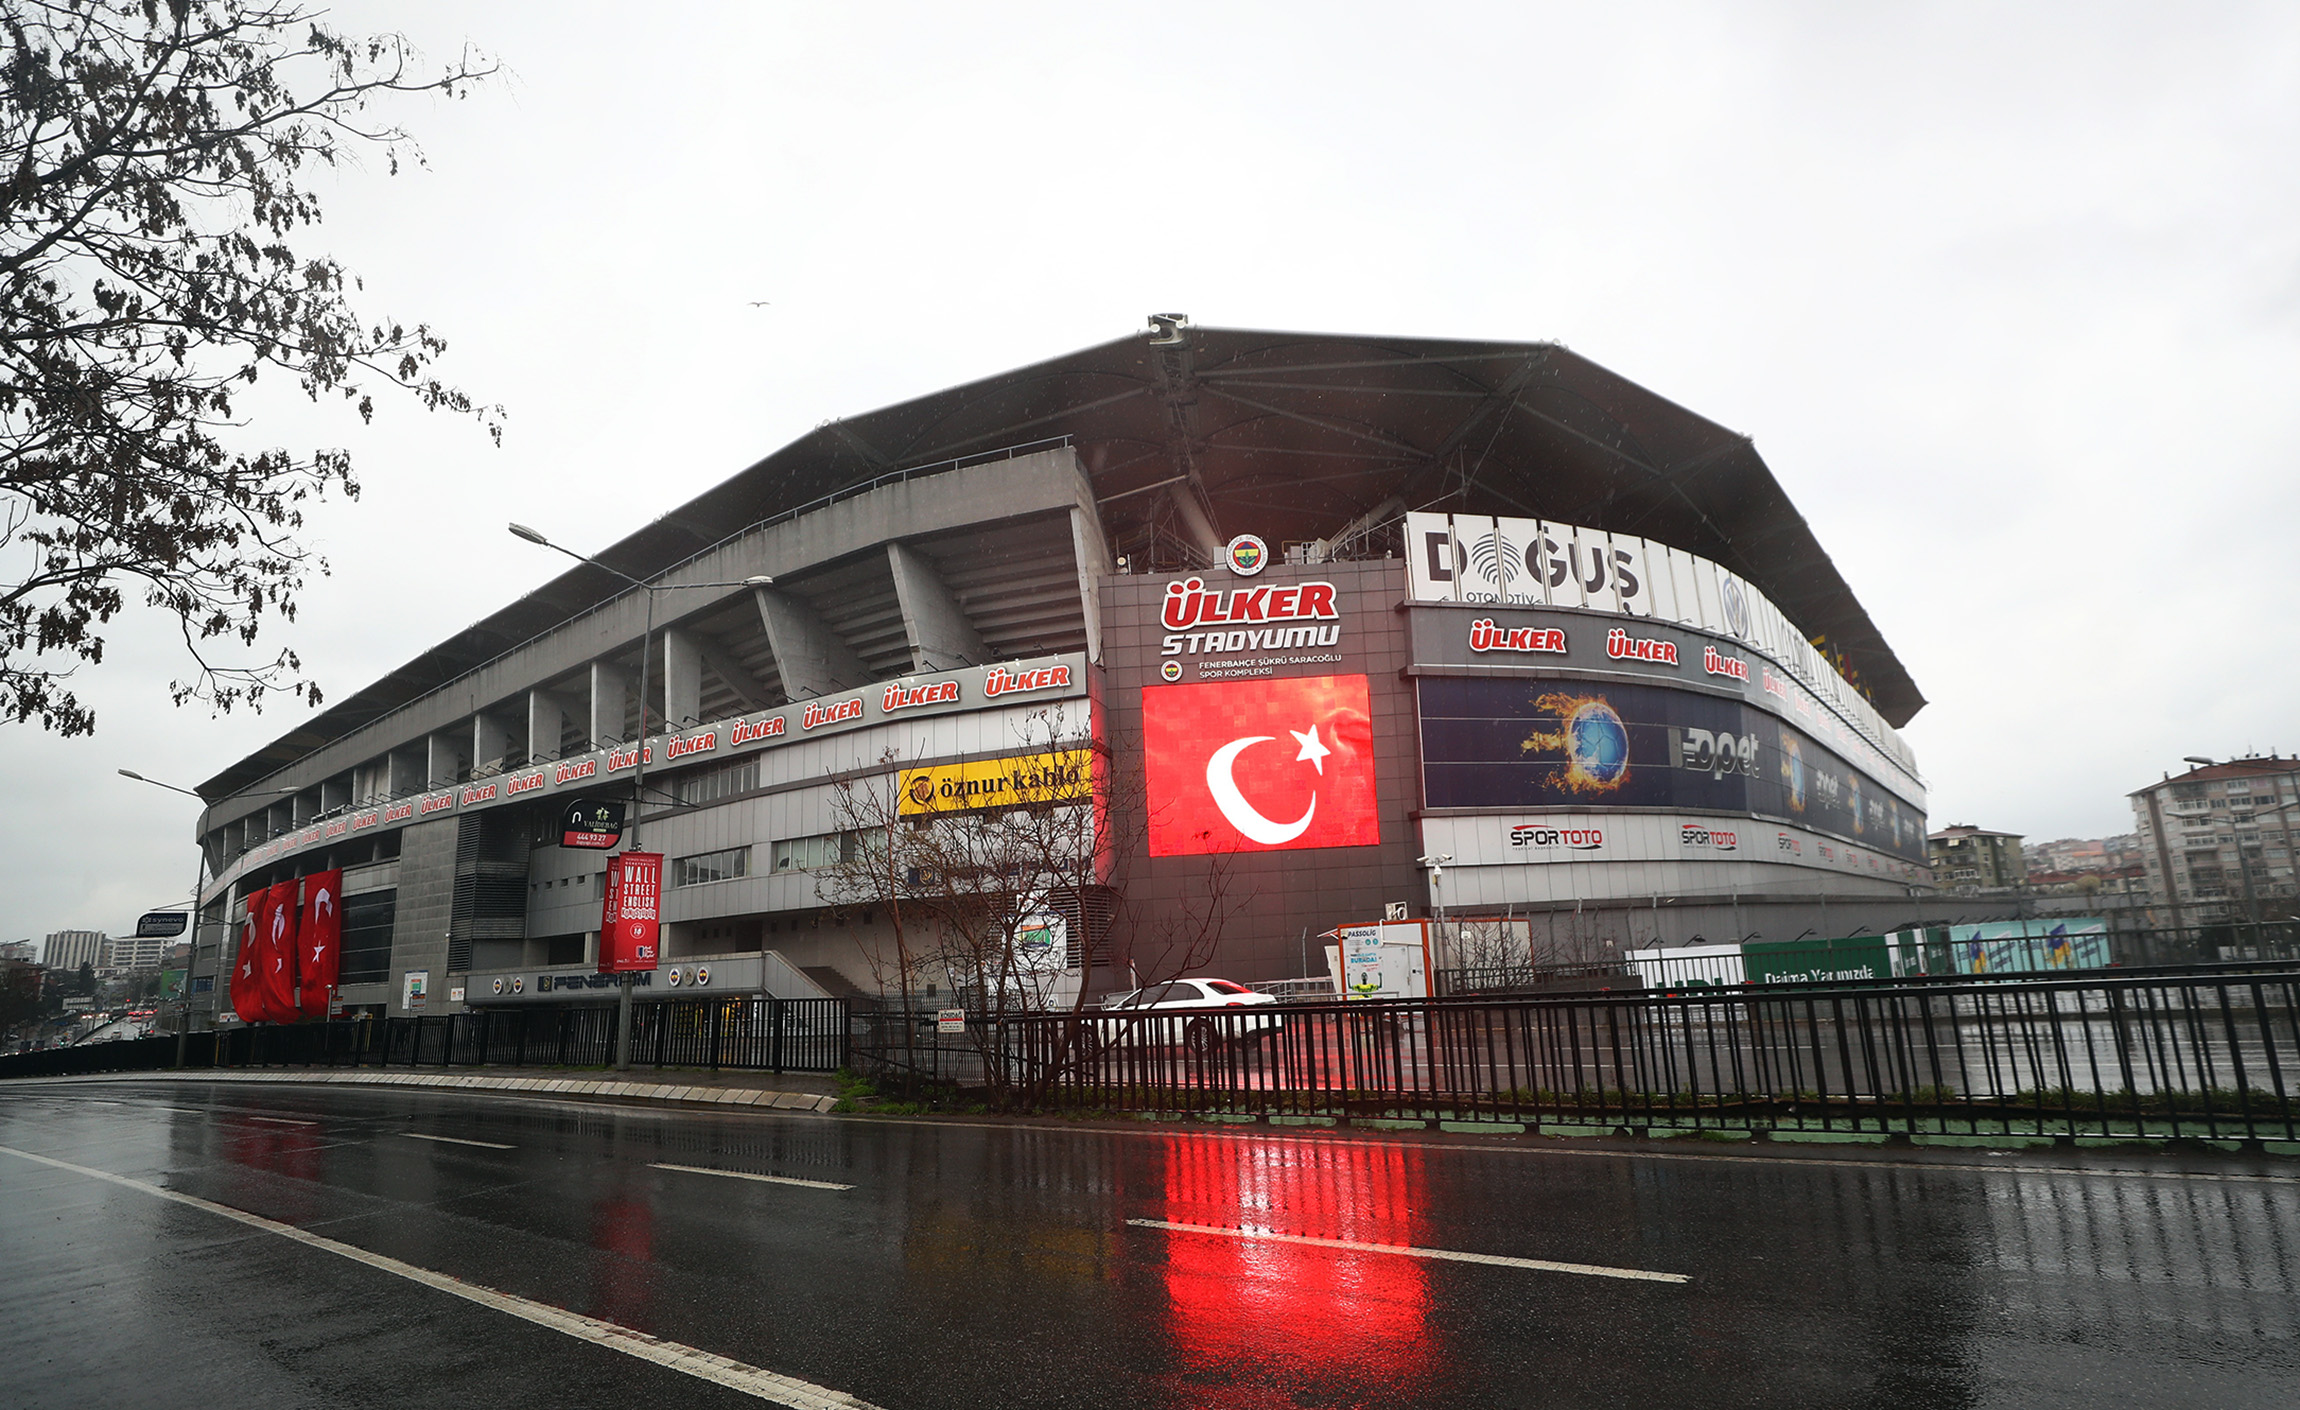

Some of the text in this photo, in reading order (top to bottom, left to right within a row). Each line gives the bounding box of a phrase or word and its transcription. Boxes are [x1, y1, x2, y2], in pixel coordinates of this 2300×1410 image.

[1161, 576, 1340, 631] ÜLKER
[1161, 625, 1340, 656] STADYUMU
[1469, 618, 1567, 653] ÜLKER
[1606, 628, 1679, 666] ÜLKER
[1199, 653, 1342, 669] FENERBAHÇE ŞÜKRÜ SARACOĞLU
[1199, 666, 1273, 679] SPOR KOMPLEKSİ
[1704, 645, 1750, 683] ÜLKER
[984, 665, 1070, 698] ÜLKER
[882, 680, 960, 713] ÜLKER
[802, 698, 863, 730] ÜLKER
[731, 716, 786, 746] ÜLKER
[667, 732, 716, 760] ÜLKER
[1683, 728, 1760, 780] opet
[507, 772, 545, 796] ÜLKER
[555, 759, 597, 785] ÜLKER
[940, 764, 1081, 799] öznur kablo
[420, 795, 452, 816] ÜLKER
[462, 784, 497, 807] ÜLKER
[384, 803, 413, 825] ÜLKER
[598, 834, 607, 842] 27
[624, 865, 656, 883] WALL
[623, 883, 656, 896] STREET
[623, 896, 655, 908] ENGLISH
